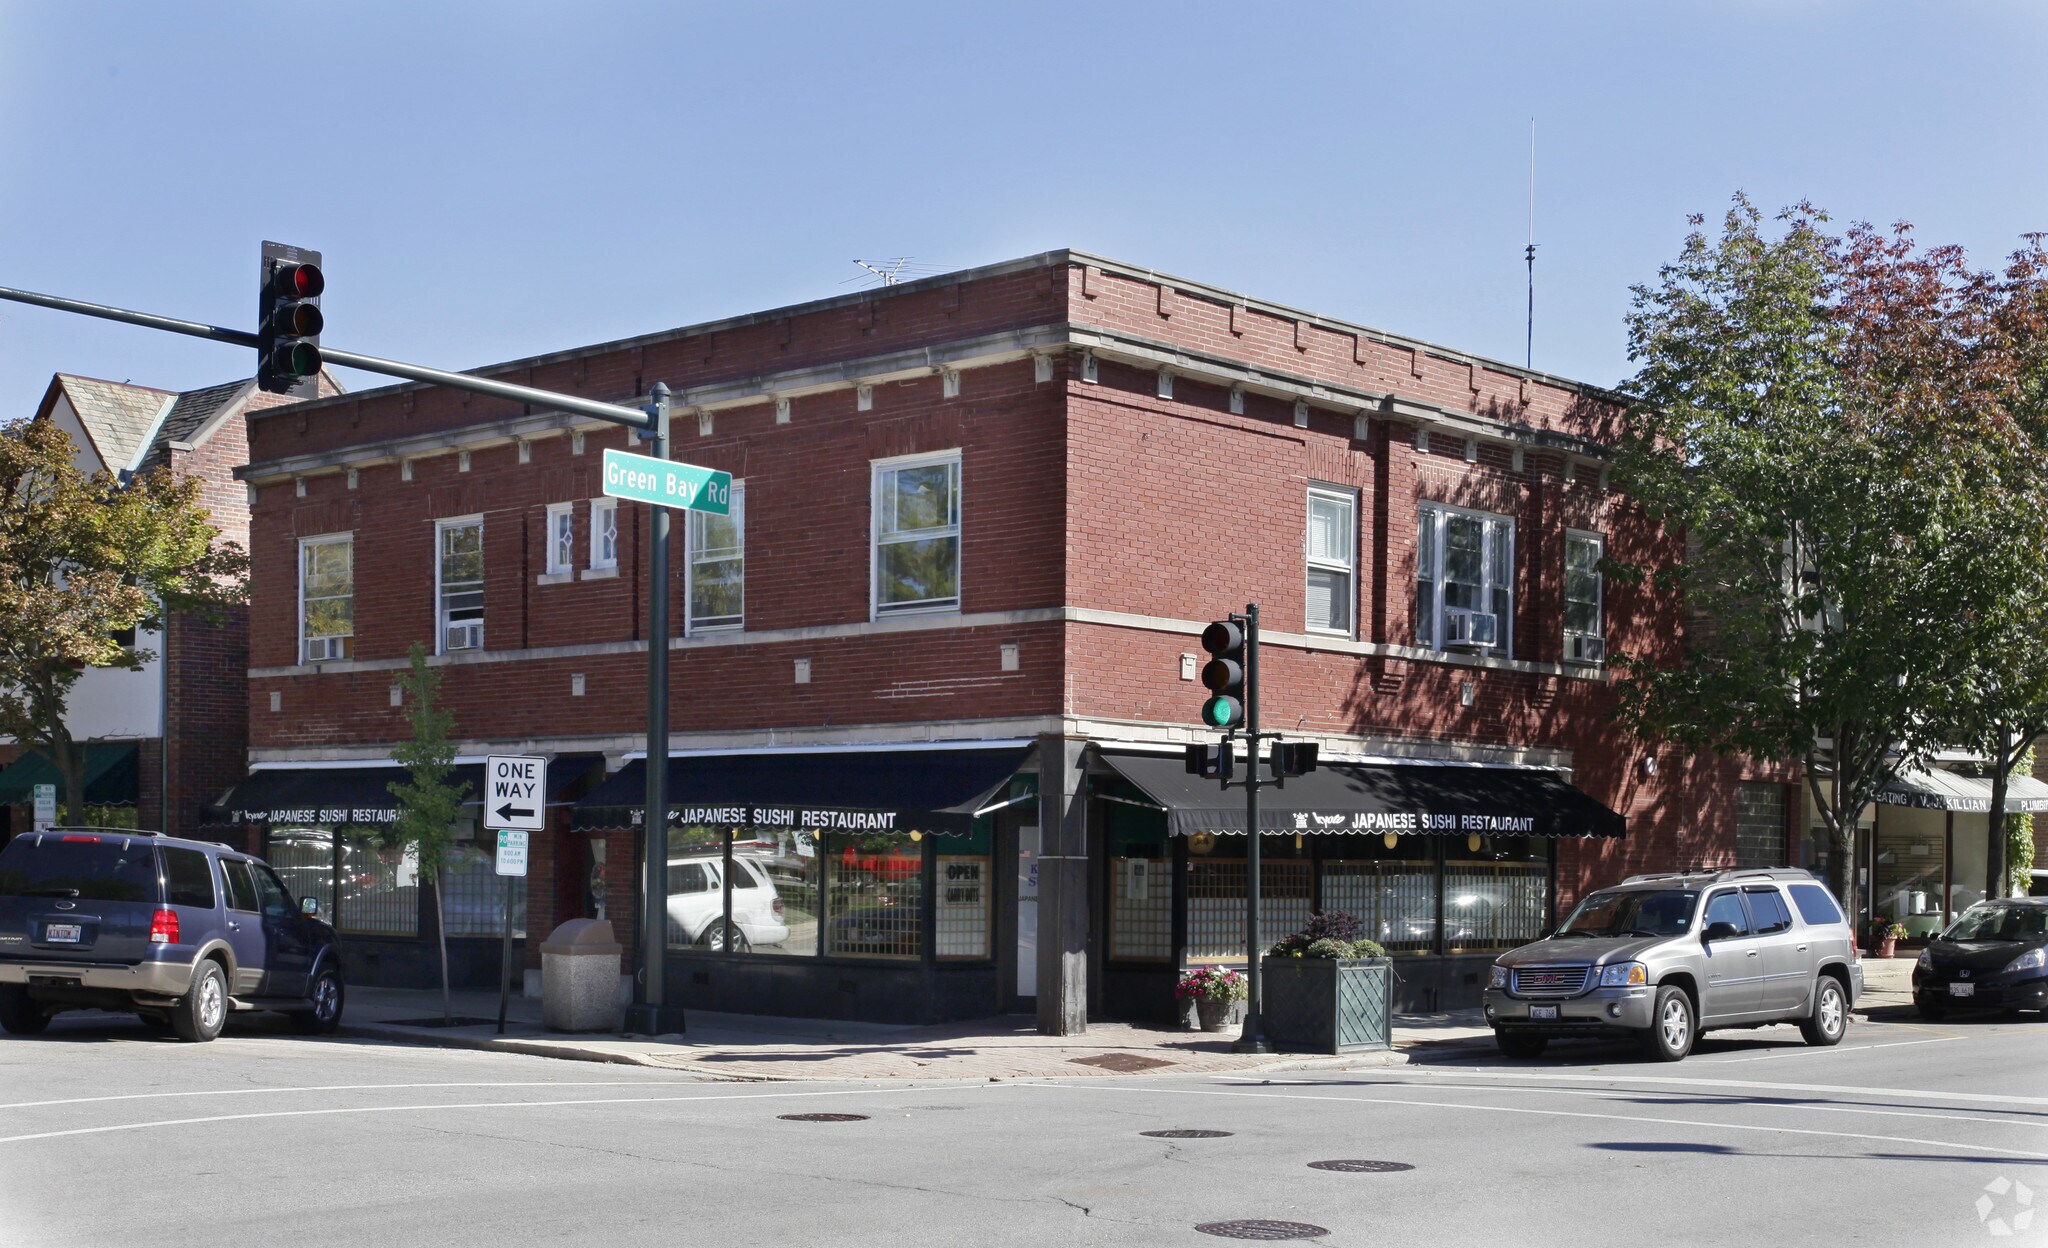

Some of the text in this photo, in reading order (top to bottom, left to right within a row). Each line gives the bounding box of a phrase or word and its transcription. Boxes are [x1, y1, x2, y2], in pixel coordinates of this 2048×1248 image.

[608, 462, 728, 505] Green Bay Rd
[497, 762, 535, 779] ONE
[495, 781, 536, 799] WAY
[1870, 789, 1907, 805] EATING
[1946, 797, 1987, 811] KILLIAN
[268, 809, 316, 823] JAPANESE
[319, 809, 348, 823] SUSHI
[681, 807, 746, 824] JAPANESE
[753, 808, 794, 825] SUSHI
[801, 810, 897, 829] RESTAURANT
[1312, 811, 1534, 832] kyoto JAPANESE SUSHI RESTAURANT
[499, 834, 508, 844] 90
[948, 864, 978, 880] OPEN
[1533, 974, 1565, 984] GMC
